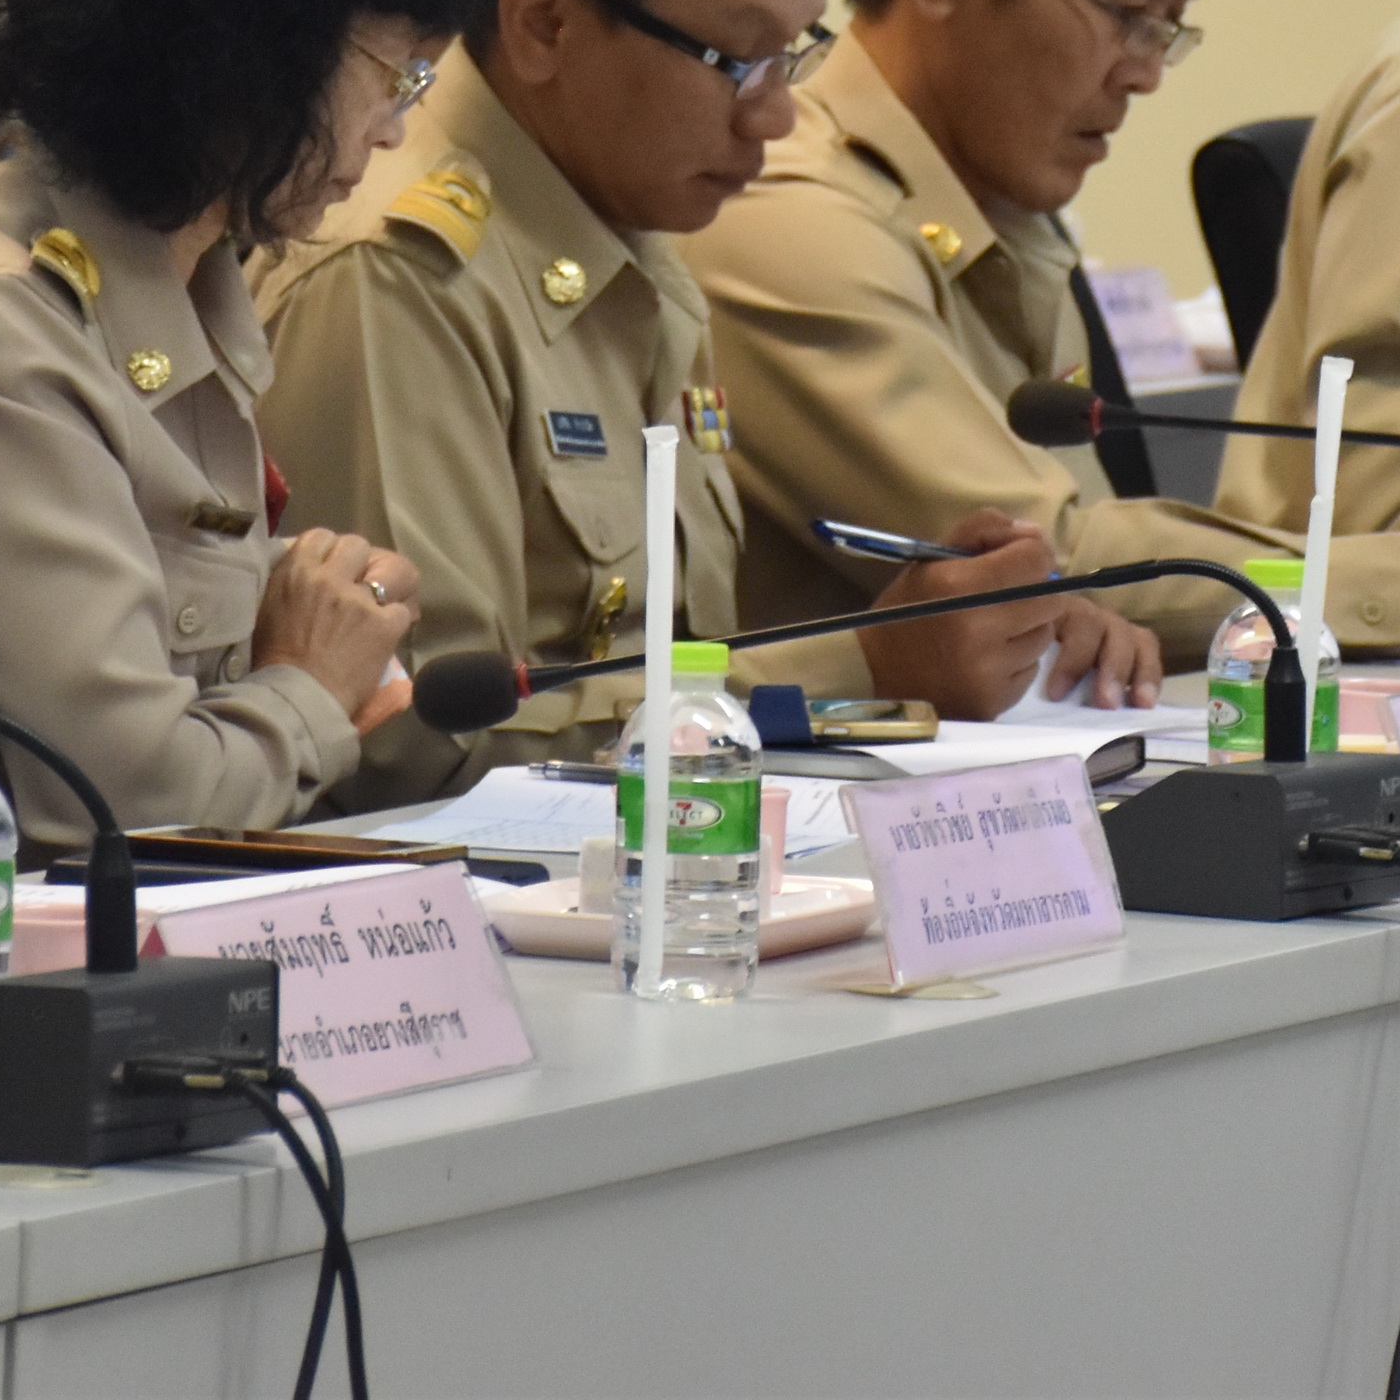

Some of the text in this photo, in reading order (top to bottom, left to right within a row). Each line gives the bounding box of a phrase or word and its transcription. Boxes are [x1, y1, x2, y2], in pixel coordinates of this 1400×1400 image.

[357, 898, 458, 960] หน่อแก้ว
[228, 987, 272, 1014] NPE
